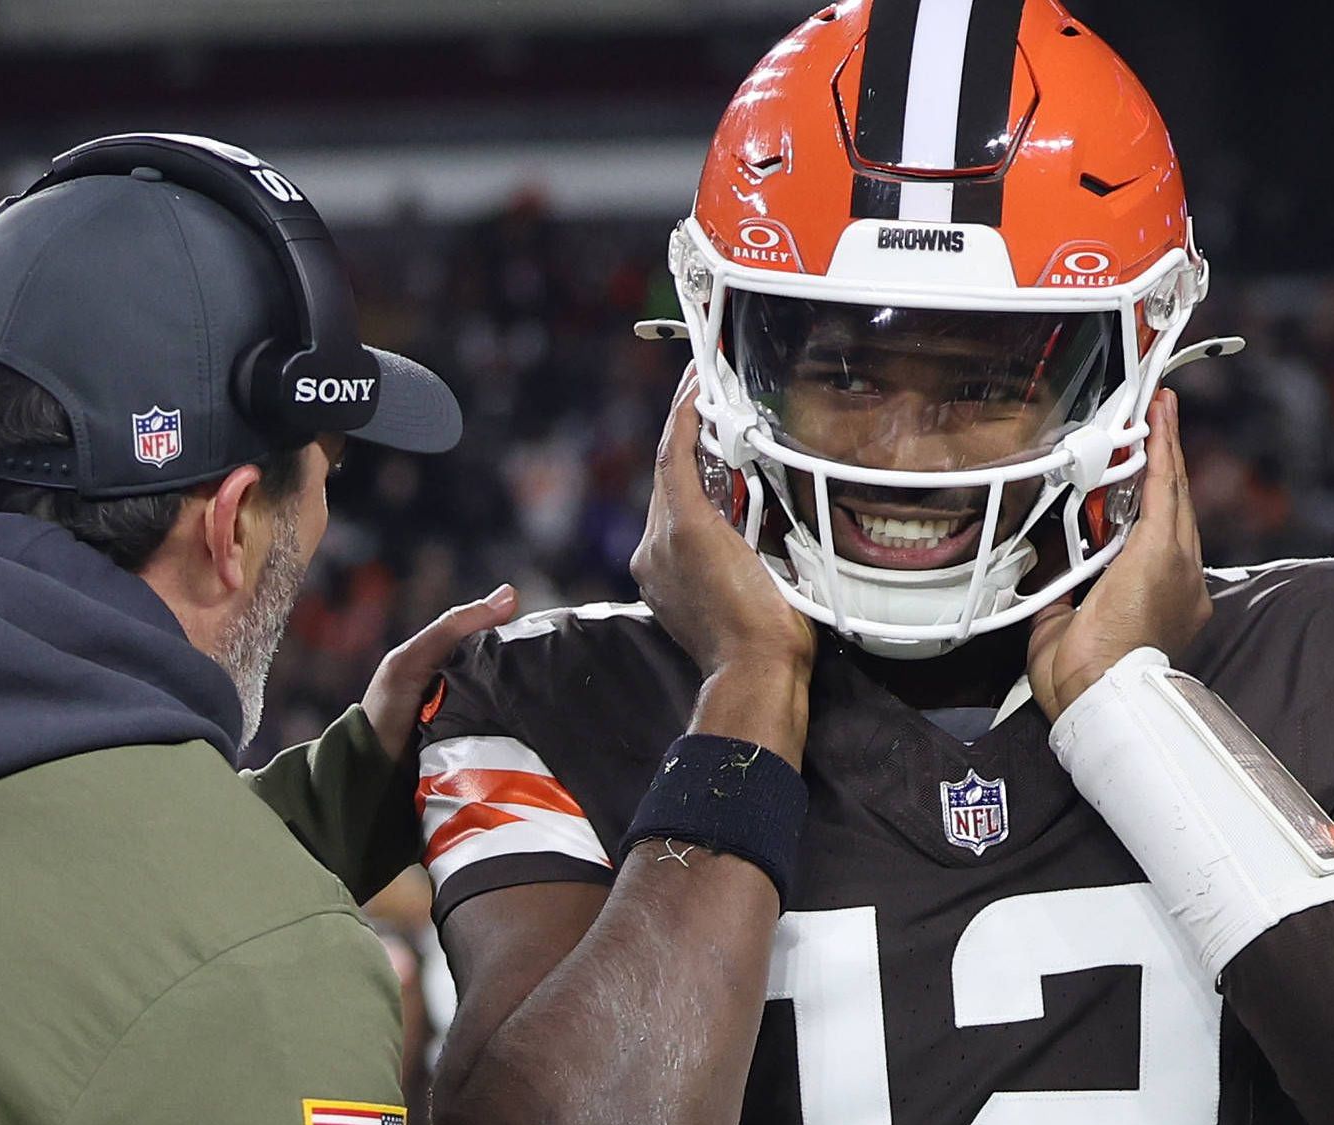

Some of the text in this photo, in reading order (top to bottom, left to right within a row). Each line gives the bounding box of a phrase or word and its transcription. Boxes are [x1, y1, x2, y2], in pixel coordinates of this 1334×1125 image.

[878, 227, 965, 253] BROWNS
[733, 246, 789, 263] OAKLEY
[1051, 273, 1116, 286] OAKLEY
[295, 377, 375, 403] SONY
[141, 433, 177, 459] NFL
[954, 808, 999, 839] NFL
